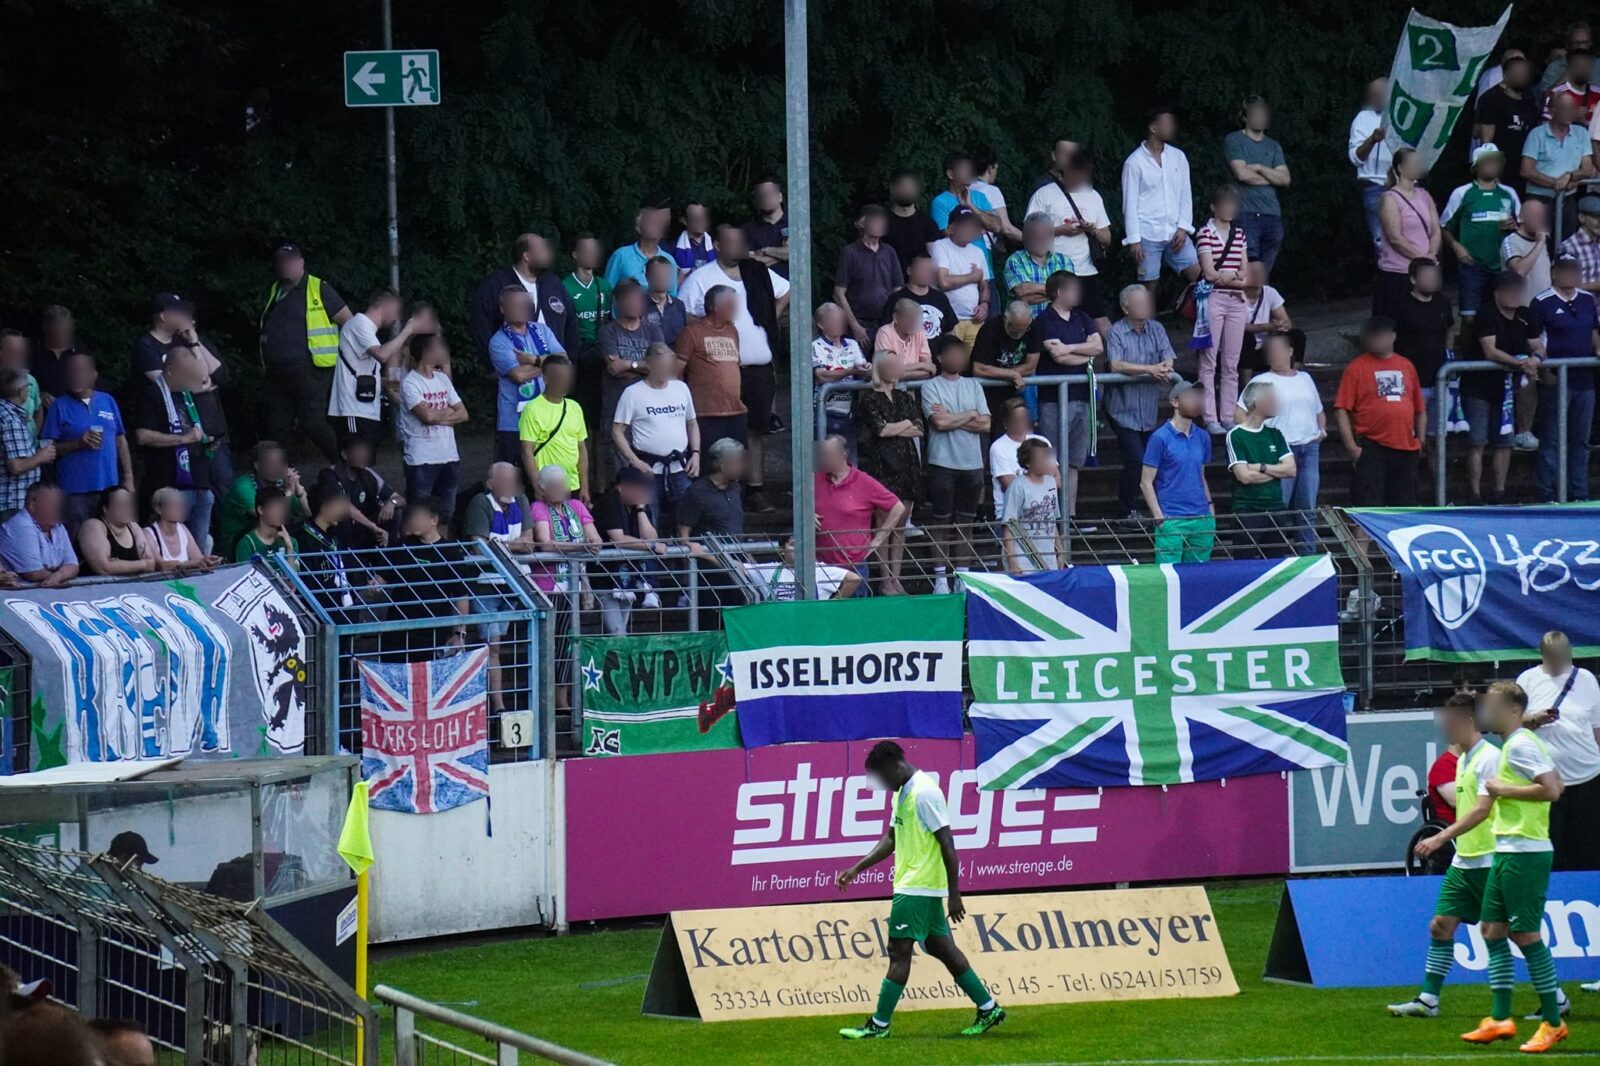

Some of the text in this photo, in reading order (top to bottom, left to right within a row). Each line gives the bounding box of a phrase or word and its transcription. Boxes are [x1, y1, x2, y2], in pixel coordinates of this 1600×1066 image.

[1418, 34, 1444, 65] 2
[1411, 549, 1476, 571] FCG
[603, 650, 716, 705] CWPW
[749, 651, 943, 690] ISSELHORST
[996, 648, 1315, 701] LEICESTER
[511, 722, 522, 745] 3
[733, 762, 1047, 849] strege
[752, 875, 770, 891] Ihr
[771, 873, 811, 890] Partner
[815, 869, 831, 887] für
[834, 868, 884, 885] Iustrie
[977, 854, 1073, 876] www.strenge.de
[969, 910, 1212, 957] Kollmeyer
[711, 990, 772, 1011] 33334
[777, 984, 871, 1007] Gütersloh
[1009, 975, 1041, 995] 145
[1058, 973, 1093, 992] Tel:
[1100, 965, 1223, 991] 05241/51759
